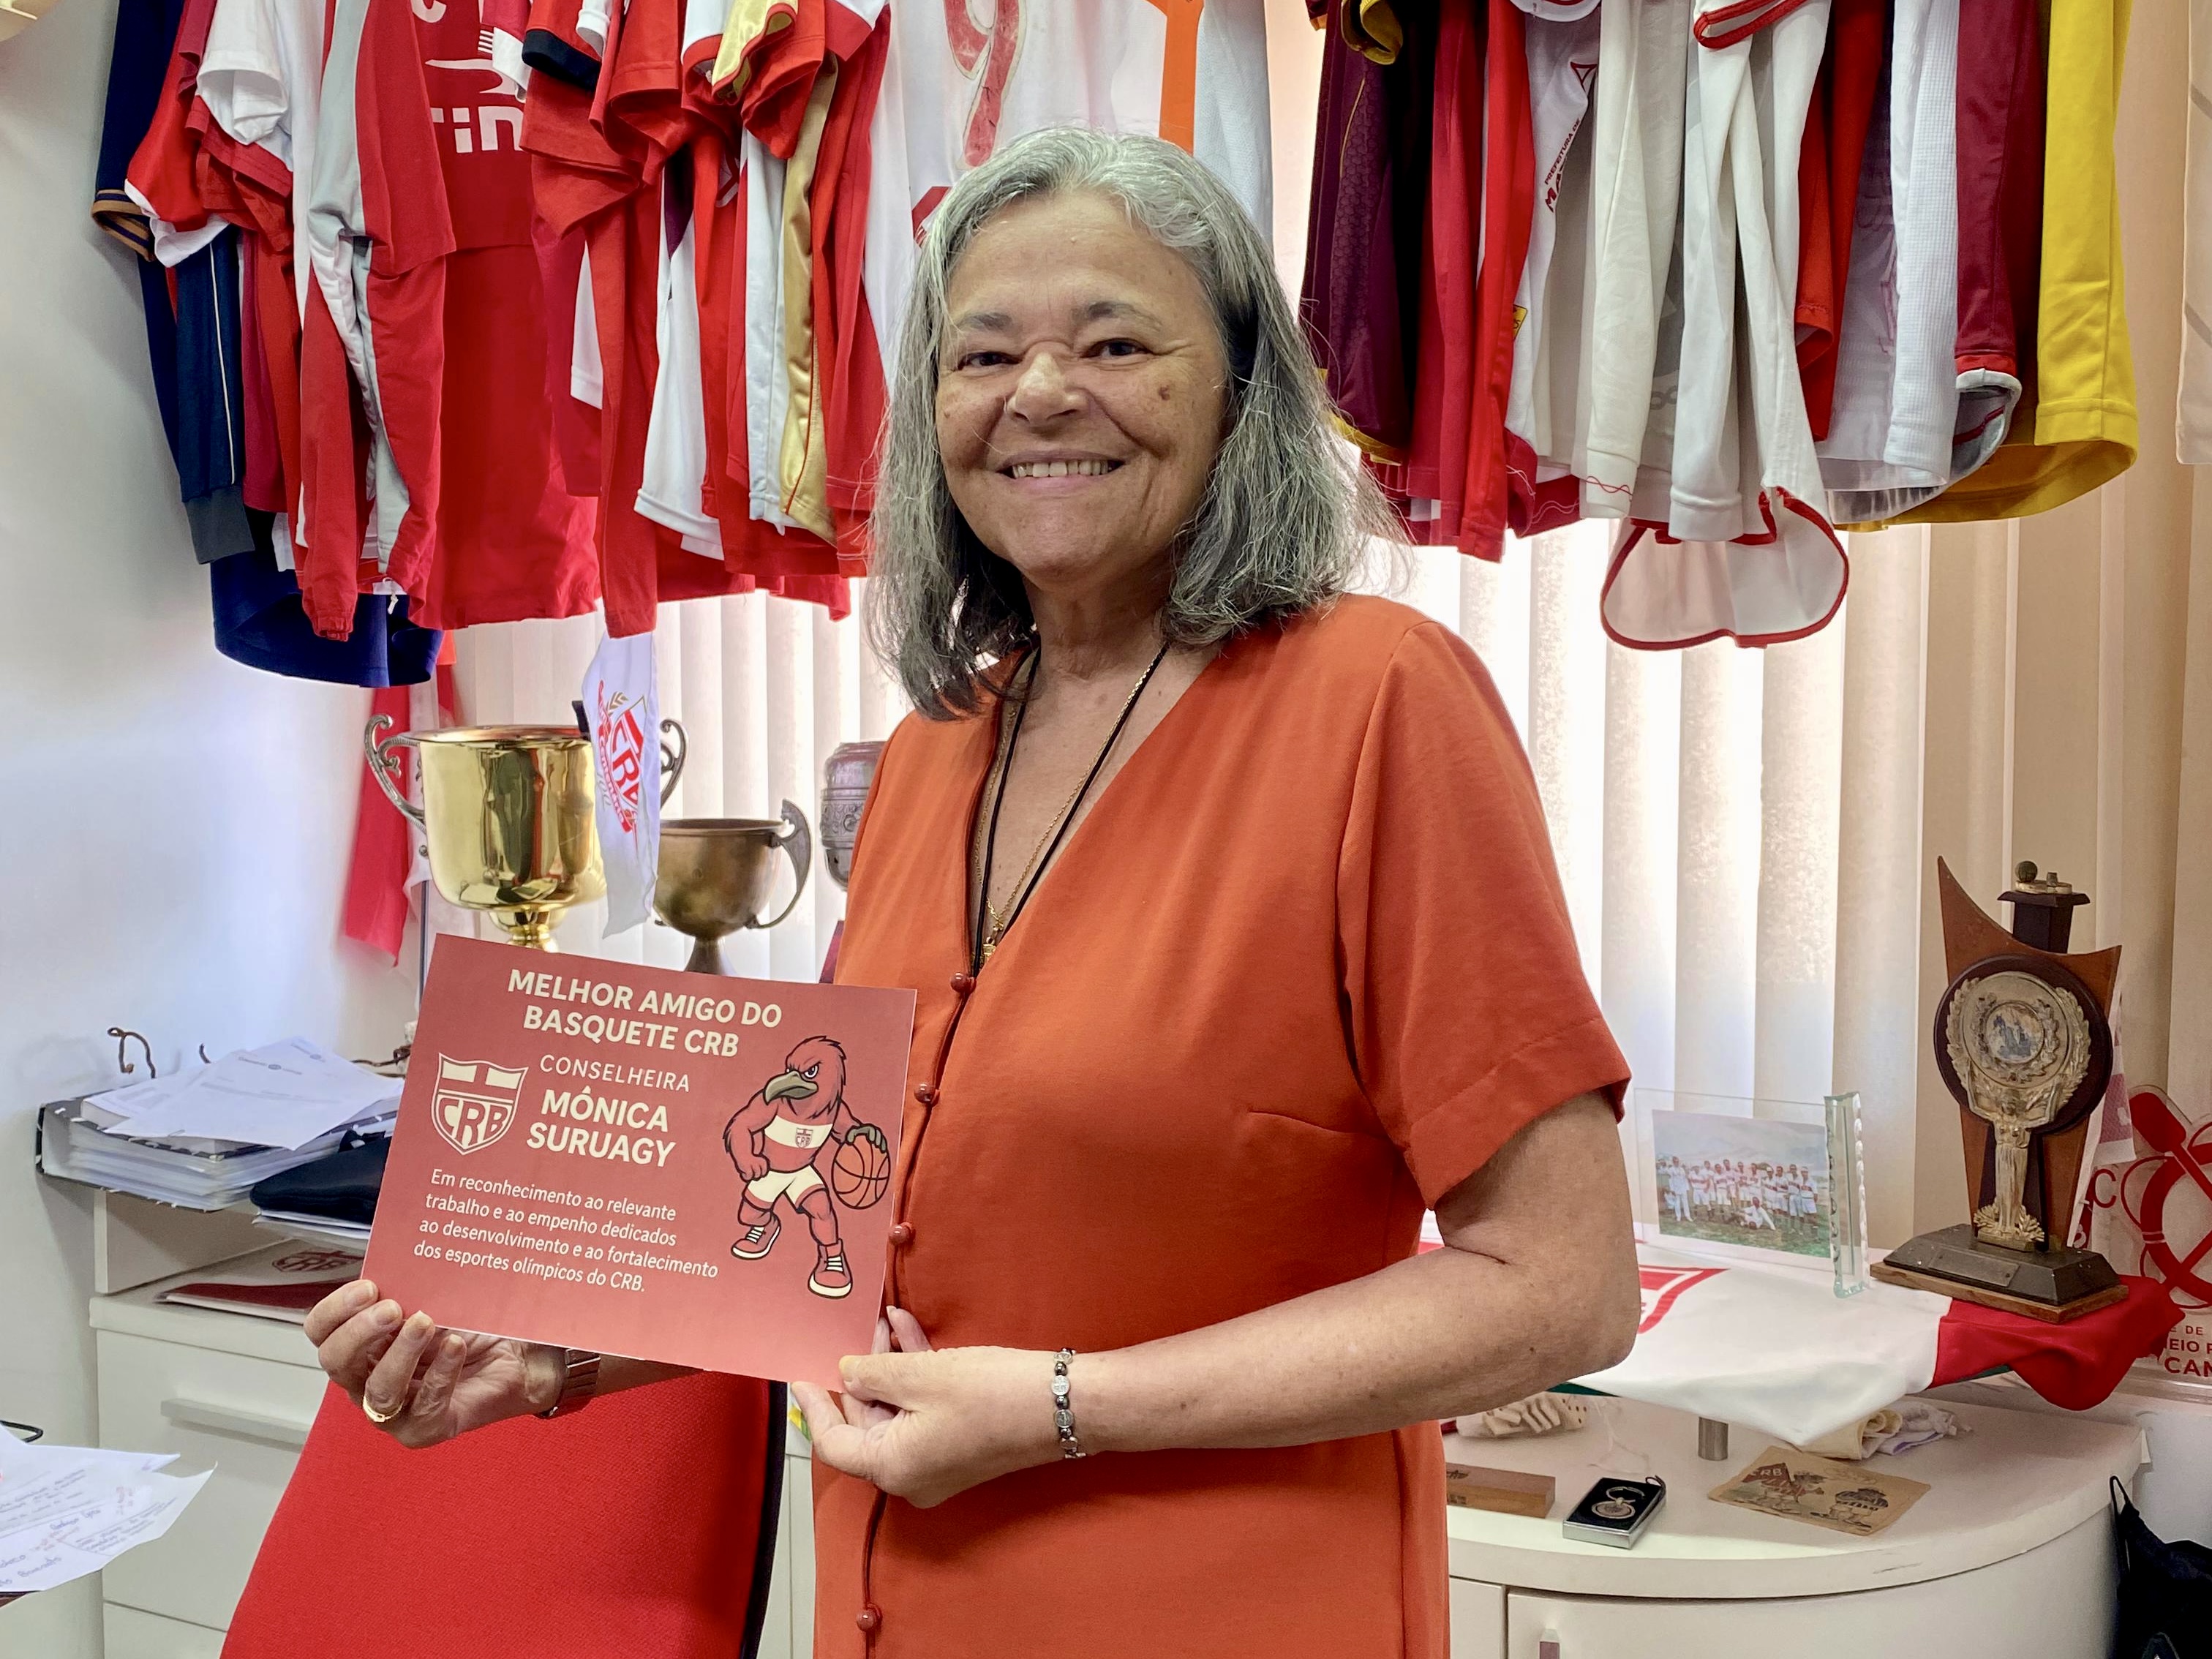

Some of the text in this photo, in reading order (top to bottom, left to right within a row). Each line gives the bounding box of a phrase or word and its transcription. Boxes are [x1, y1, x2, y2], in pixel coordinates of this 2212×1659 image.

[1544, 117, 1581, 185] PREFEITURA DE
[508, 968, 782, 1028] MELHOR AMIGO DO
[523, 1005, 740, 1057] BASQUETE CRB
[540, 1054, 690, 1092] CONSELHEIRA
[438, 1097, 508, 1146] CRB
[526, 1122, 677, 1167] SURUAGY
[426, 1193, 677, 1246] trabalho e ao empenho dedicados
[431, 1168, 676, 1221] Em reconhecimento ao relevante
[414, 1240, 644, 1292] dos esportes olímpicos do CRB.
[419, 1219, 718, 1278] ao desenvolvimento e ao fortalecimento
[2186, 1325, 2204, 1336] DE
